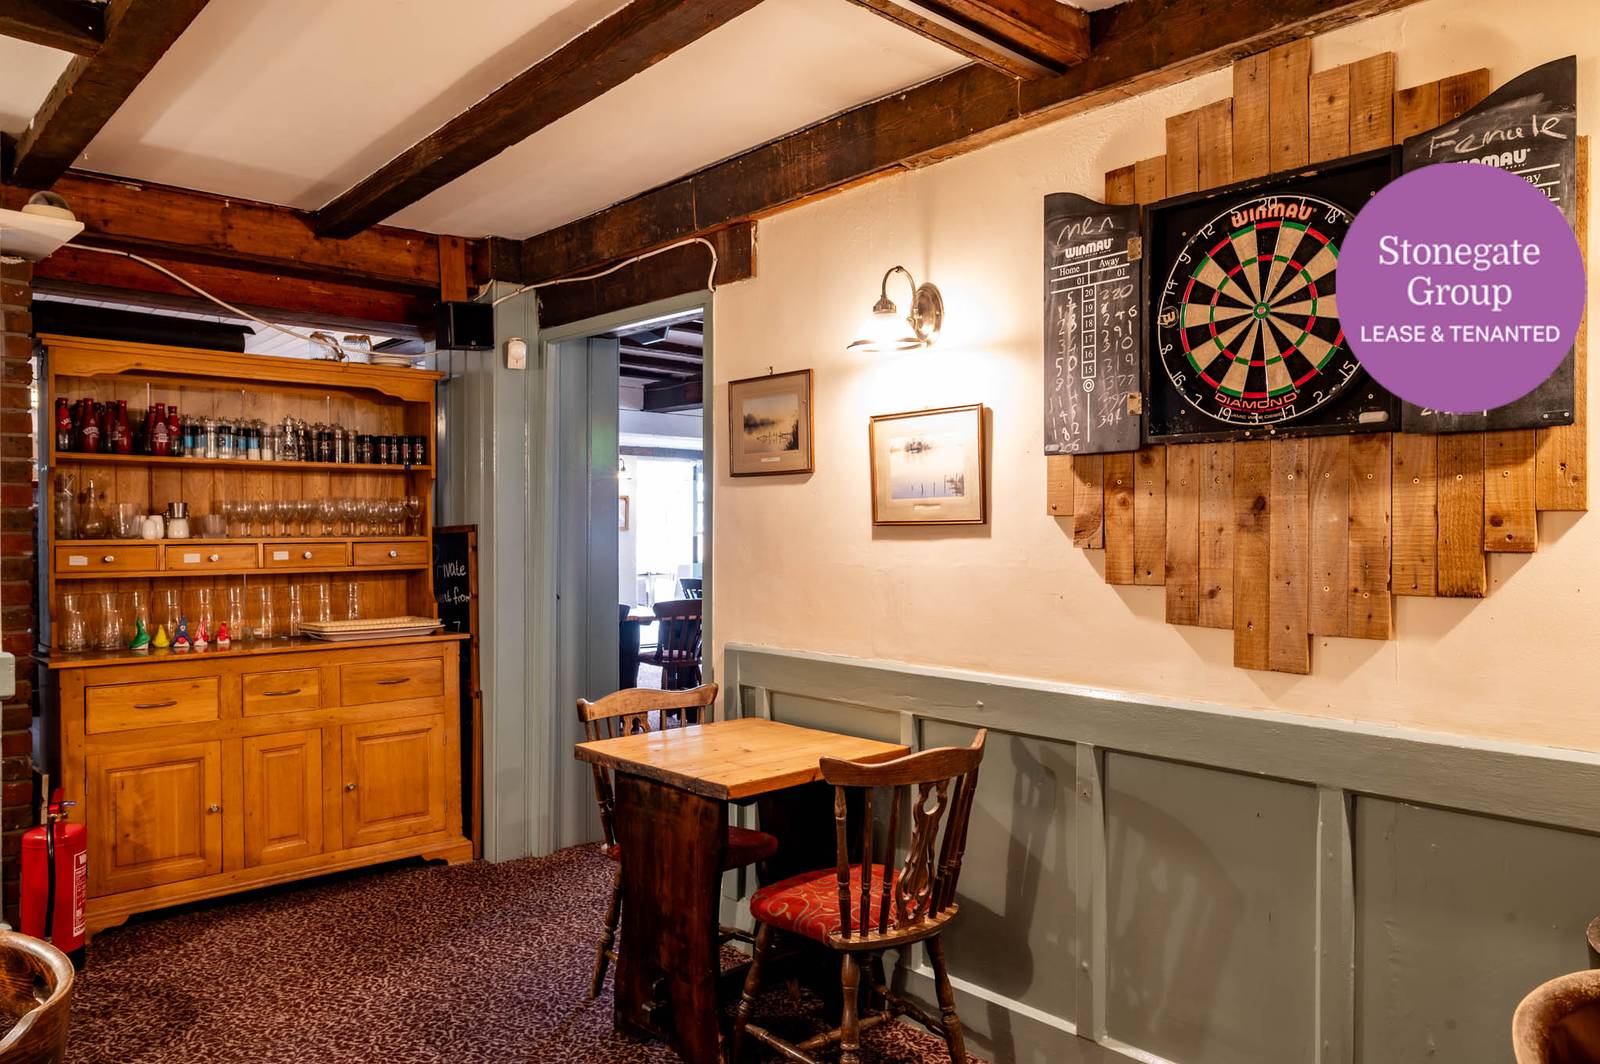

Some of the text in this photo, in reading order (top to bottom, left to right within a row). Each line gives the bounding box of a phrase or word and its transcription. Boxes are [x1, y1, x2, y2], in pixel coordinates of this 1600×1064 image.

[1065, 239, 1112, 258] WINMAU
[1060, 258, 1120, 276] Home Away
[1077, 268, 1126, 285] 01 01
[1085, 289, 1093, 297] 20
[1085, 304, 1093, 313] 19
[1085, 320, 1093, 328] 18
[1085, 335, 1093, 343] 17
[1085, 350, 1093, 359] 16
[1085, 366, 1093, 374] 15
[1215, 392, 1297, 409] DIAMOND
